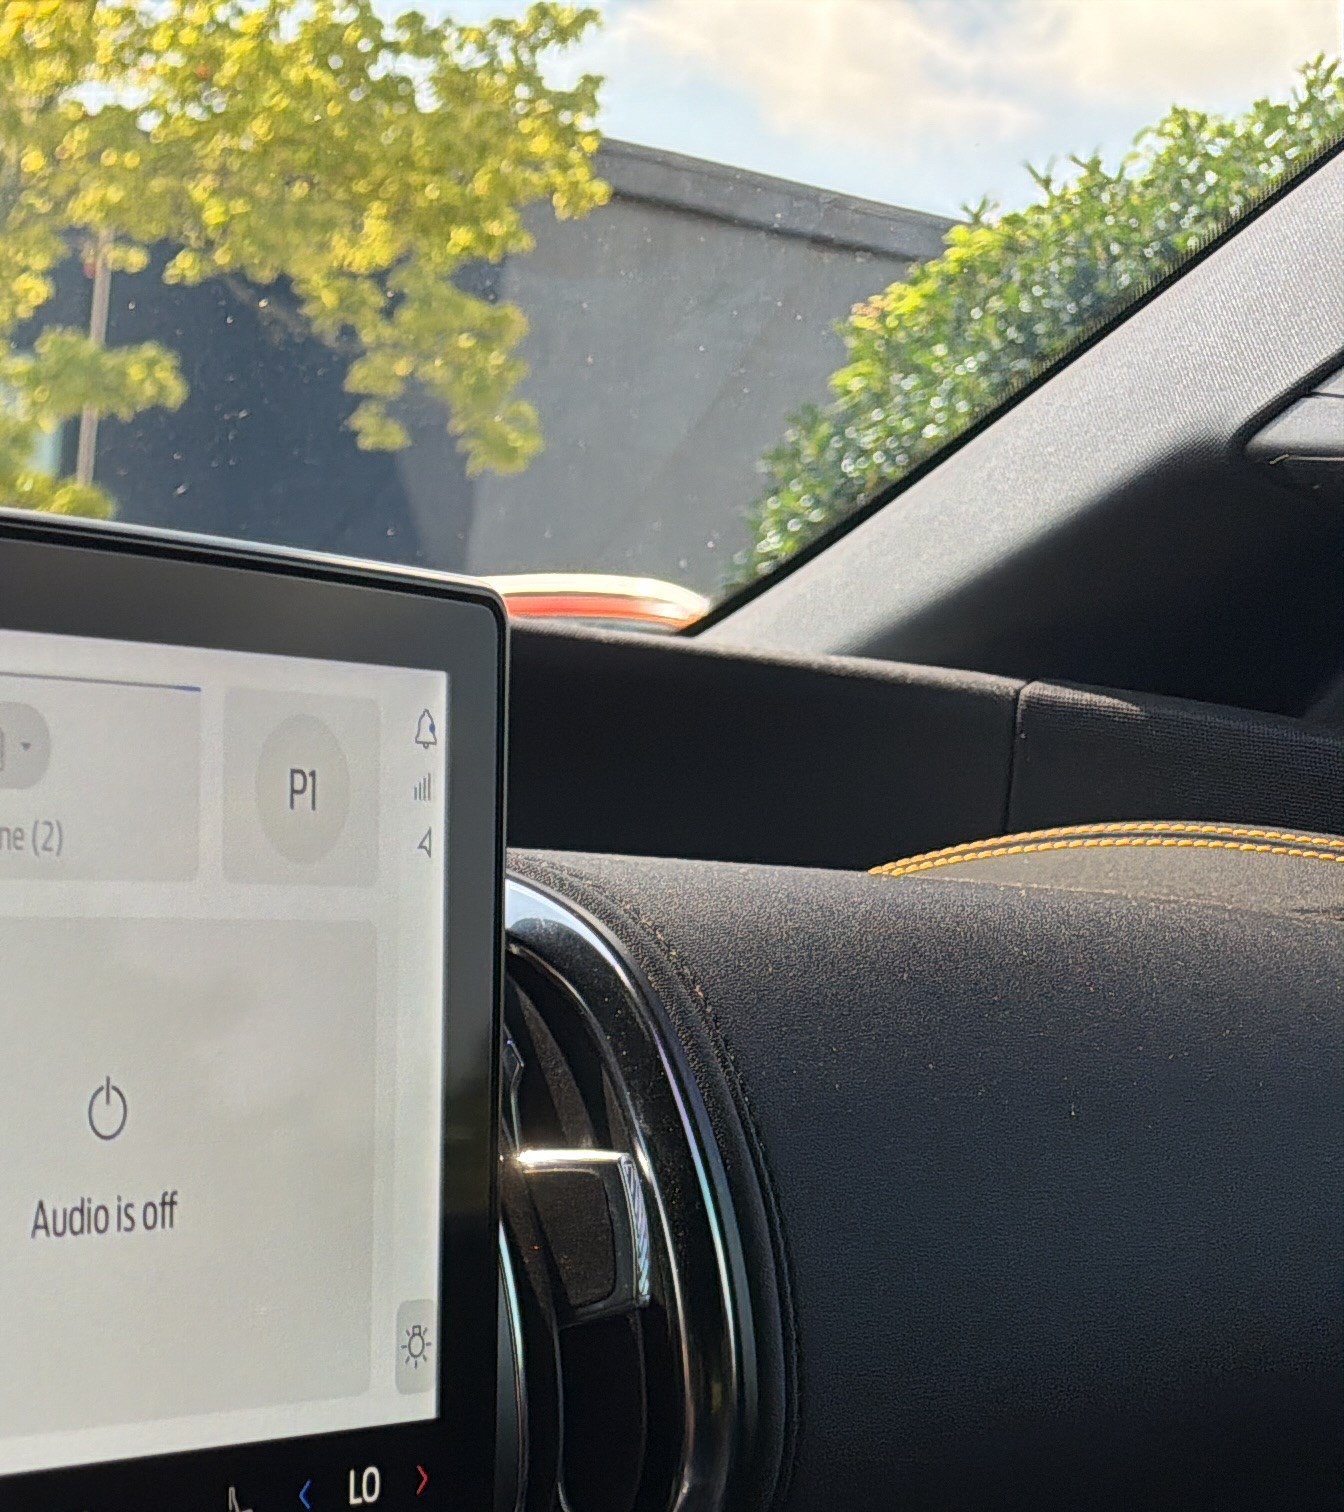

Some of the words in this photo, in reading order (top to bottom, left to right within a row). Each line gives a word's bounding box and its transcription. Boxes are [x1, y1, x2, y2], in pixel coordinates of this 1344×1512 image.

[288, 767, 317, 811] P1
[30, 819, 64, 858] (2)
[30, 1196, 111, 1240] Audio
[116, 1194, 135, 1233] is
[141, 1189, 179, 1230] off
[348, 1466, 382, 1506] LO
